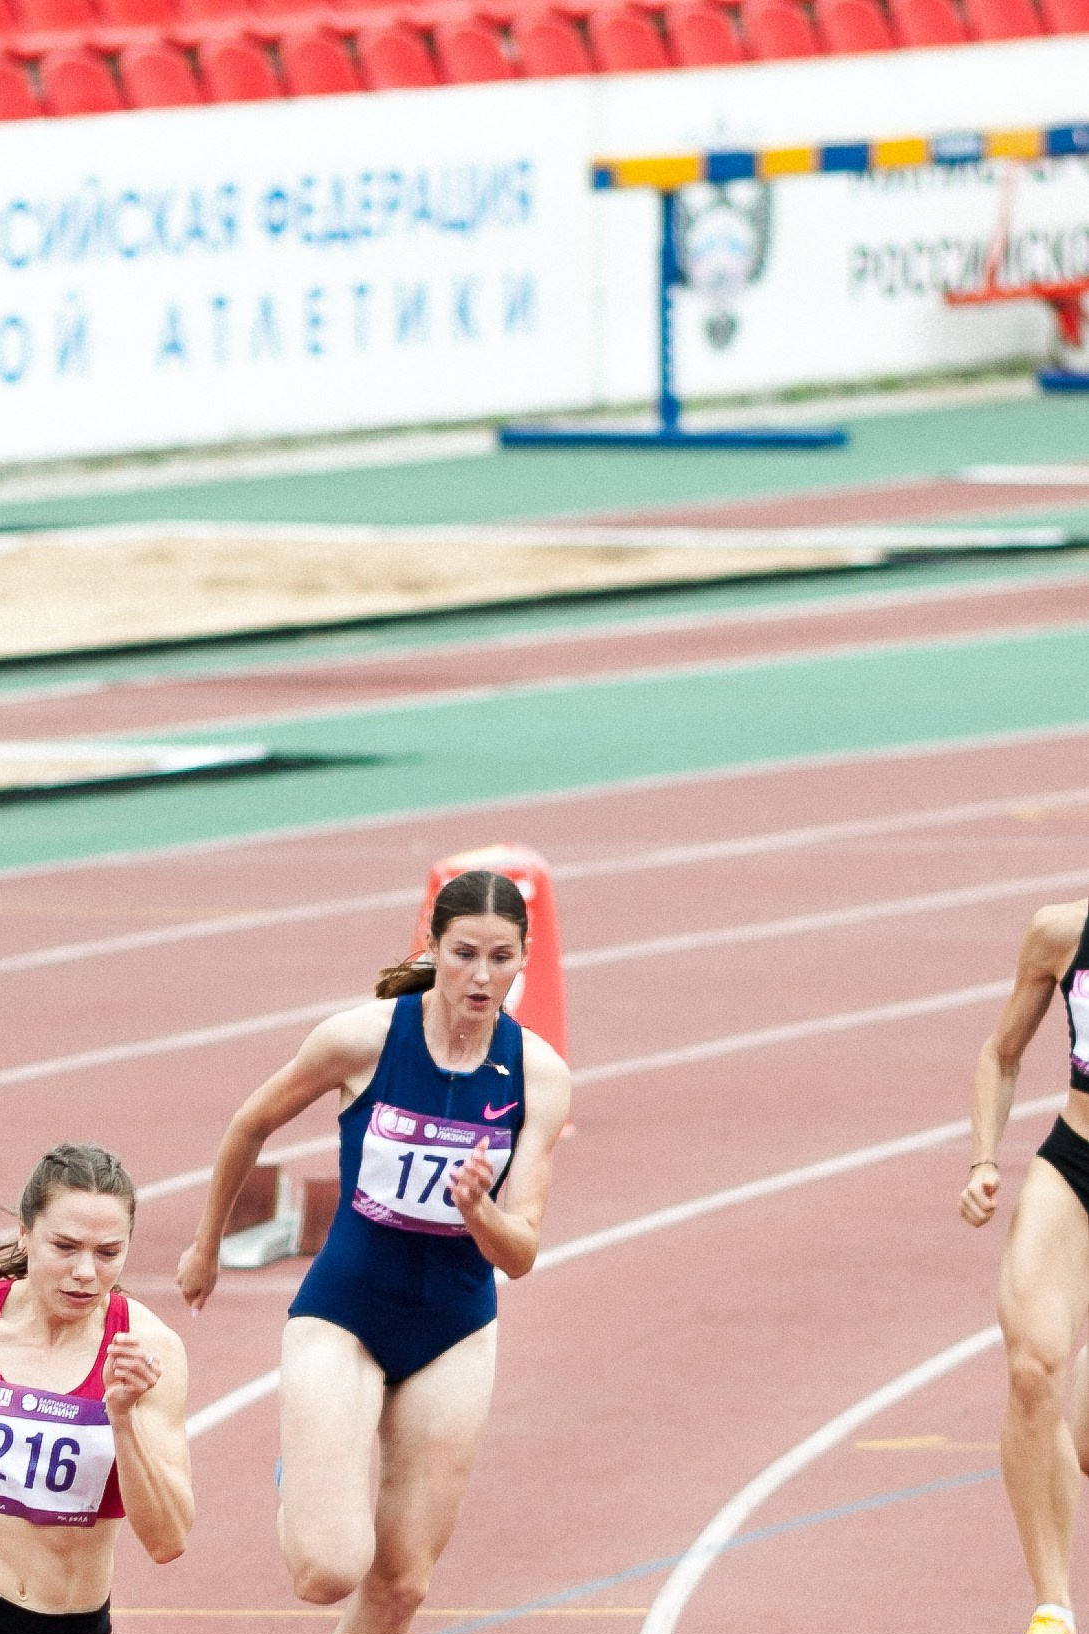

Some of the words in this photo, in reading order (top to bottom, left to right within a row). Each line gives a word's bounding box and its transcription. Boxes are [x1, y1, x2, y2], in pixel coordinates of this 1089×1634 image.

[263, 159, 532, 245] ФЕДЕРАЦИЯ
[155, 272, 538, 370] АТЛЕТИКИ
[396, 1152, 466, 1207] 17
